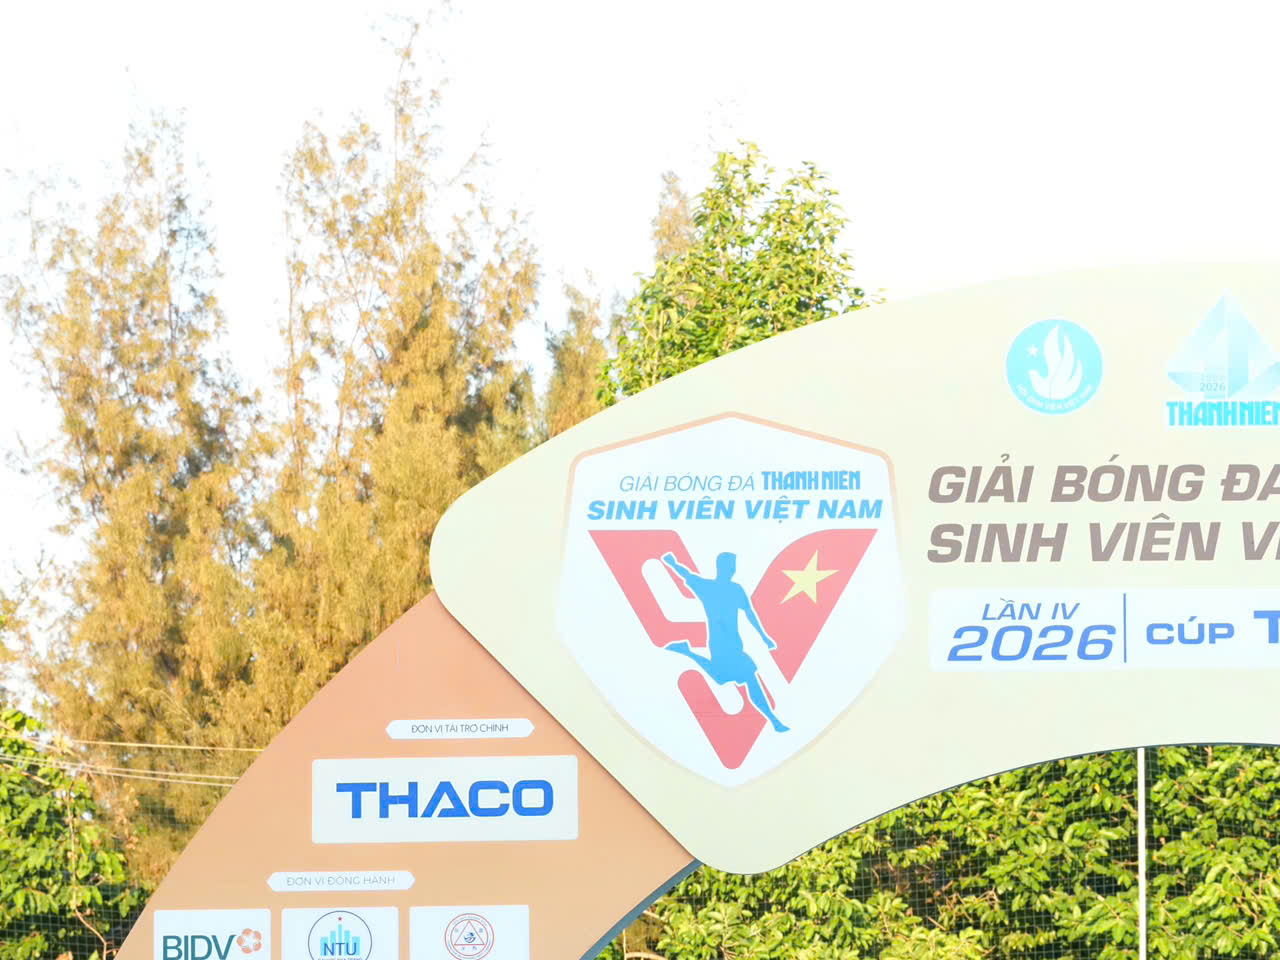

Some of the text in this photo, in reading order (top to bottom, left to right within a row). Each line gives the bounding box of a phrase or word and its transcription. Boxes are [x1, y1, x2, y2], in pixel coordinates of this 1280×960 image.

[1166, 401, 1239, 426] THANH
[663, 471, 722, 492] BÓNG
[727, 471, 755, 491] ĐÁ
[761, 470, 818, 490] THANH
[927, 453, 1034, 503] GIẢI
[1050, 454, 1205, 503] BÓNG
[587, 495, 883, 524] SINH VIÊN VIỆT NAM
[926, 522, 1068, 564] SINH
[1087, 512, 1221, 562] VIÊN
[981, 598, 1080, 621] LẦN IV
[947, 624, 1117, 662] 2026
[1146, 616, 1235, 645] CÚP
[336, 779, 554, 819] THACO
[162, 934, 235, 960] BIDV
[323, 942, 357, 956] NTU
